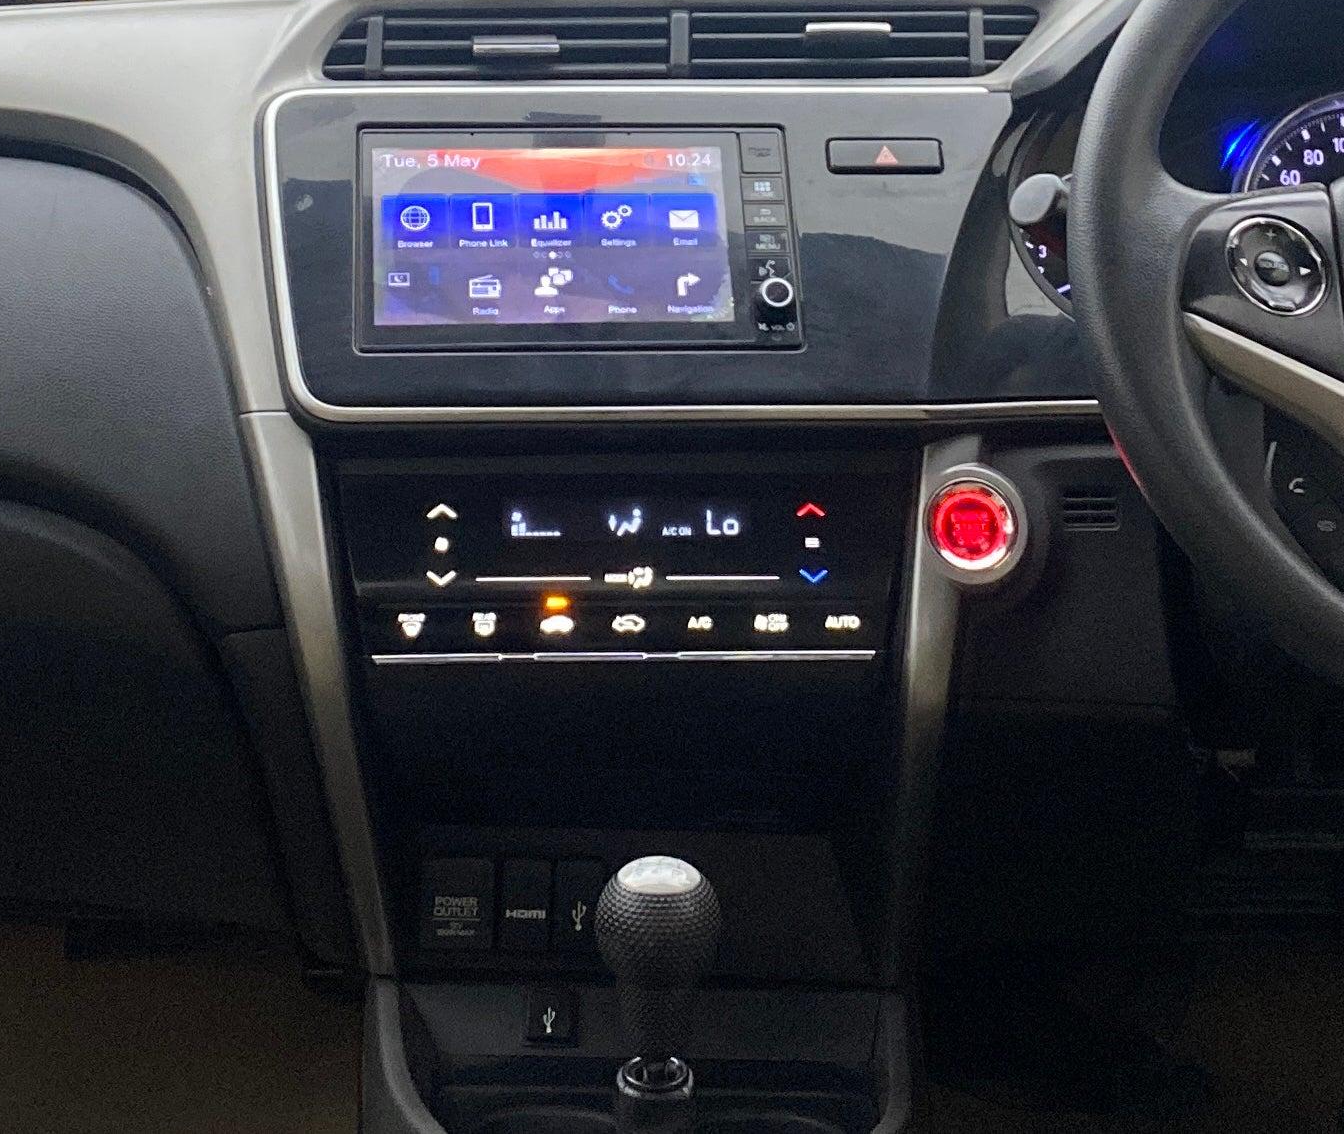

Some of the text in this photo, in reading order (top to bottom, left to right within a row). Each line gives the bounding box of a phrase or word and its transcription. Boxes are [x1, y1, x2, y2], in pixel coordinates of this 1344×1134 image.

[383, 154, 480, 170] Tue, 5 May
[1303, 149, 1324, 165] 80
[1280, 170, 1300, 185] 60
[459, 239, 508, 248] Phone Link
[1038, 244, 1047, 258] 3
[608, 305, 637, 314] Phone
[825, 615, 861, 629] AUTO
[435, 896, 478, 906] POWER
[433, 907, 479, 917] OUTLET
